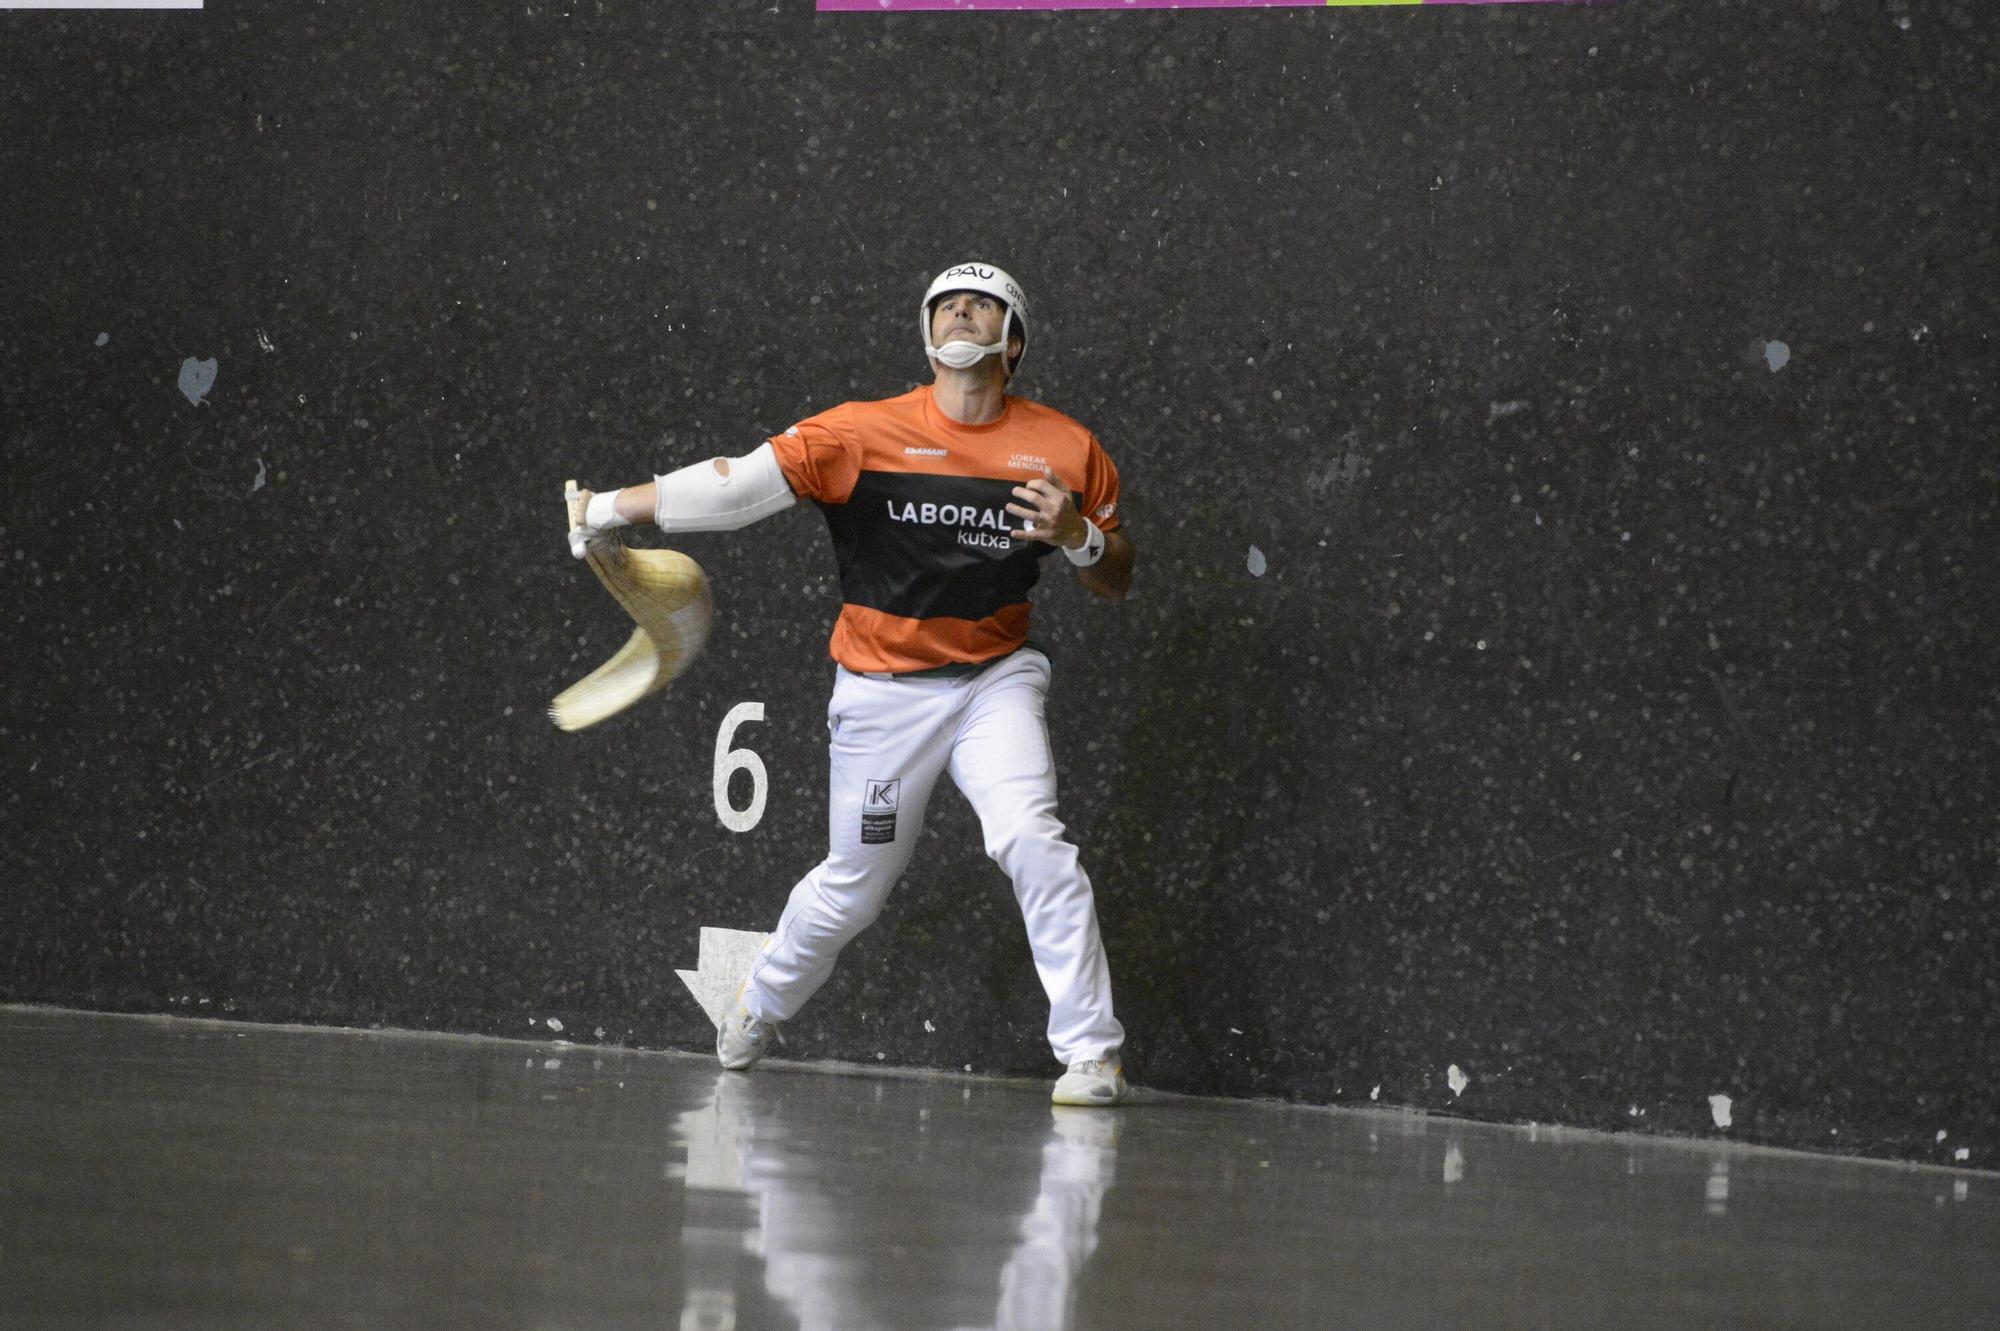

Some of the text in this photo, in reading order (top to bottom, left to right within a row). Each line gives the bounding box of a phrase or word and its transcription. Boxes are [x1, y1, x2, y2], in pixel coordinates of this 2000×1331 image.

[946, 266, 995, 280] PAU
[1010, 453, 1048, 465] LOREAK
[887, 500, 1012, 532] LABORAL
[957, 529, 1011, 550] kutxa
[713, 702, 768, 832] 6
